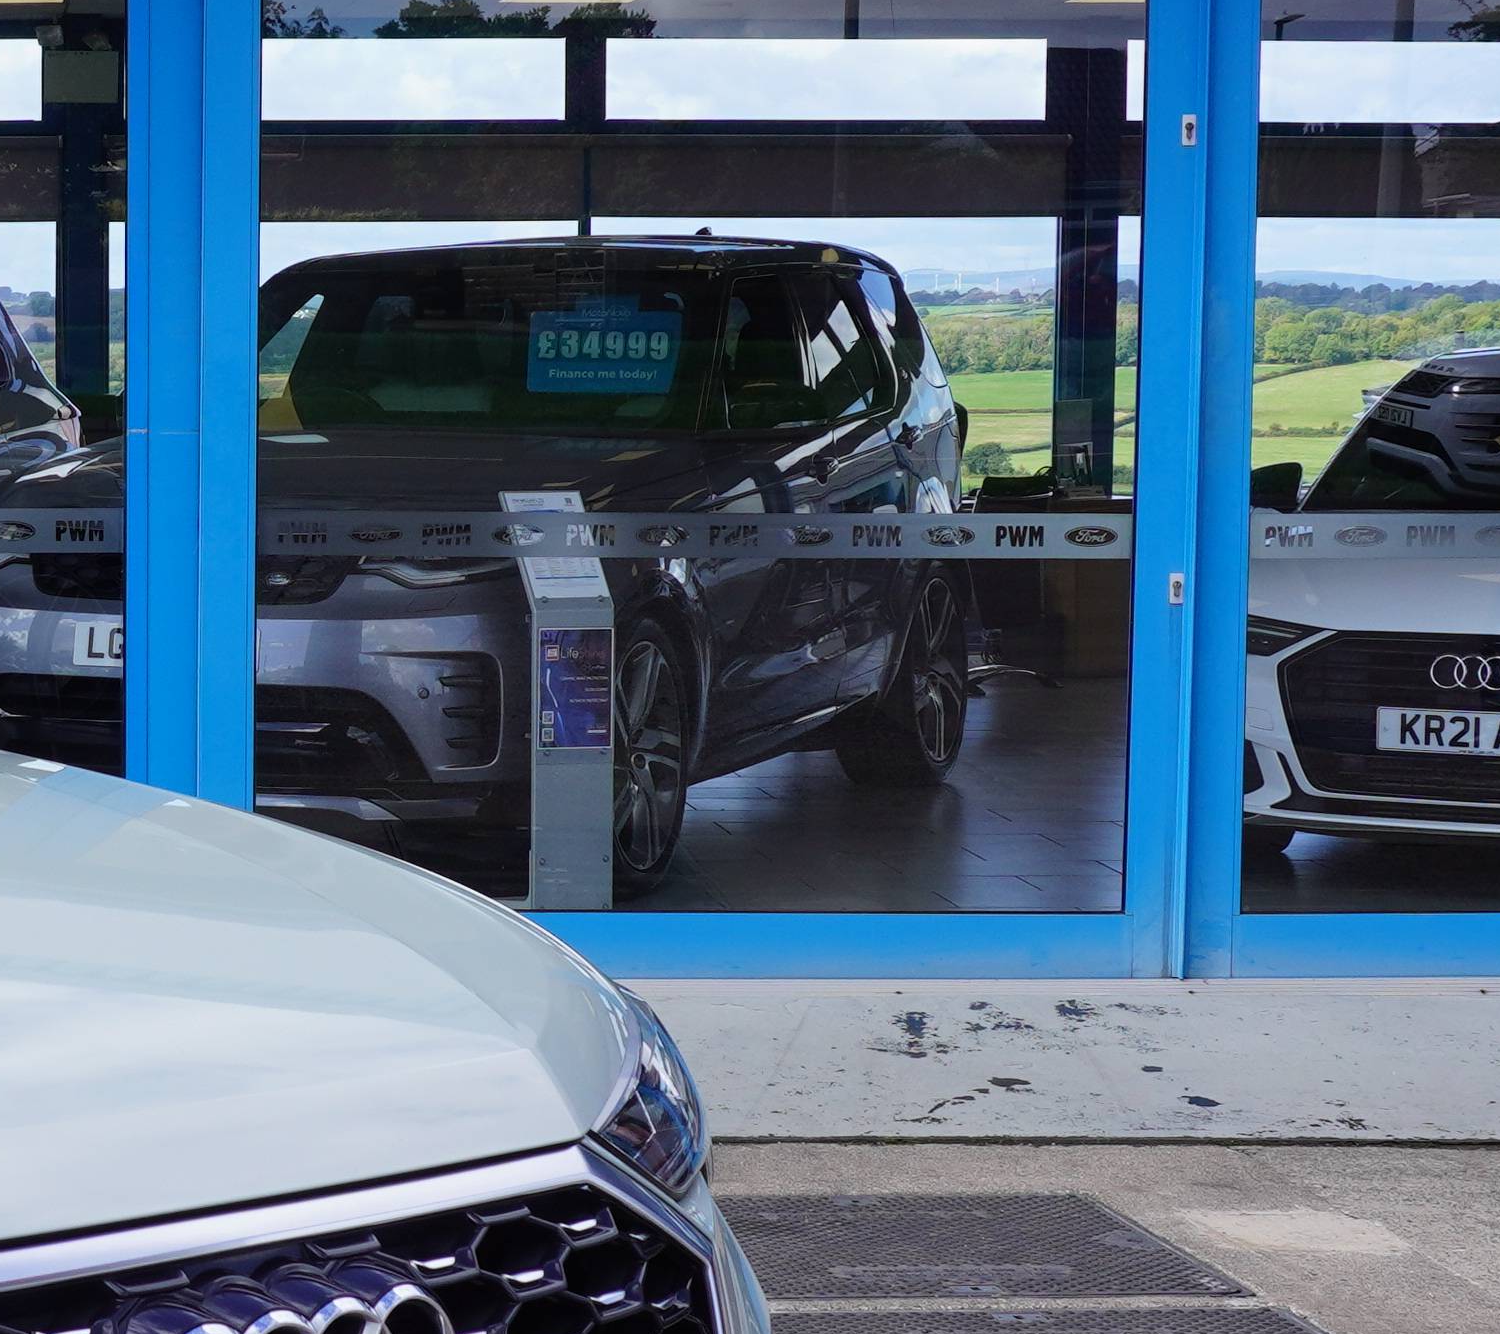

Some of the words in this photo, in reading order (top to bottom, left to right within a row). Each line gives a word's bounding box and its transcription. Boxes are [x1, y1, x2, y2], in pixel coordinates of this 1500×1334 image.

[538, 330, 669, 361] £34999
[549, 369, 594, 379] Finance
[598, 371, 616, 379] me
[619, 369, 657, 381] today!
[54, 520, 105, 542] PWM
[422, 523, 471, 546] PWM
[566, 524, 616, 546] PWM
[852, 525, 902, 547] PWM
[995, 525, 1045, 547] PWM
[1264, 525, 1314, 547] PWM
[1406, 525, 1456, 547] PWM
[1399, 713, 1481, 749] KR21
